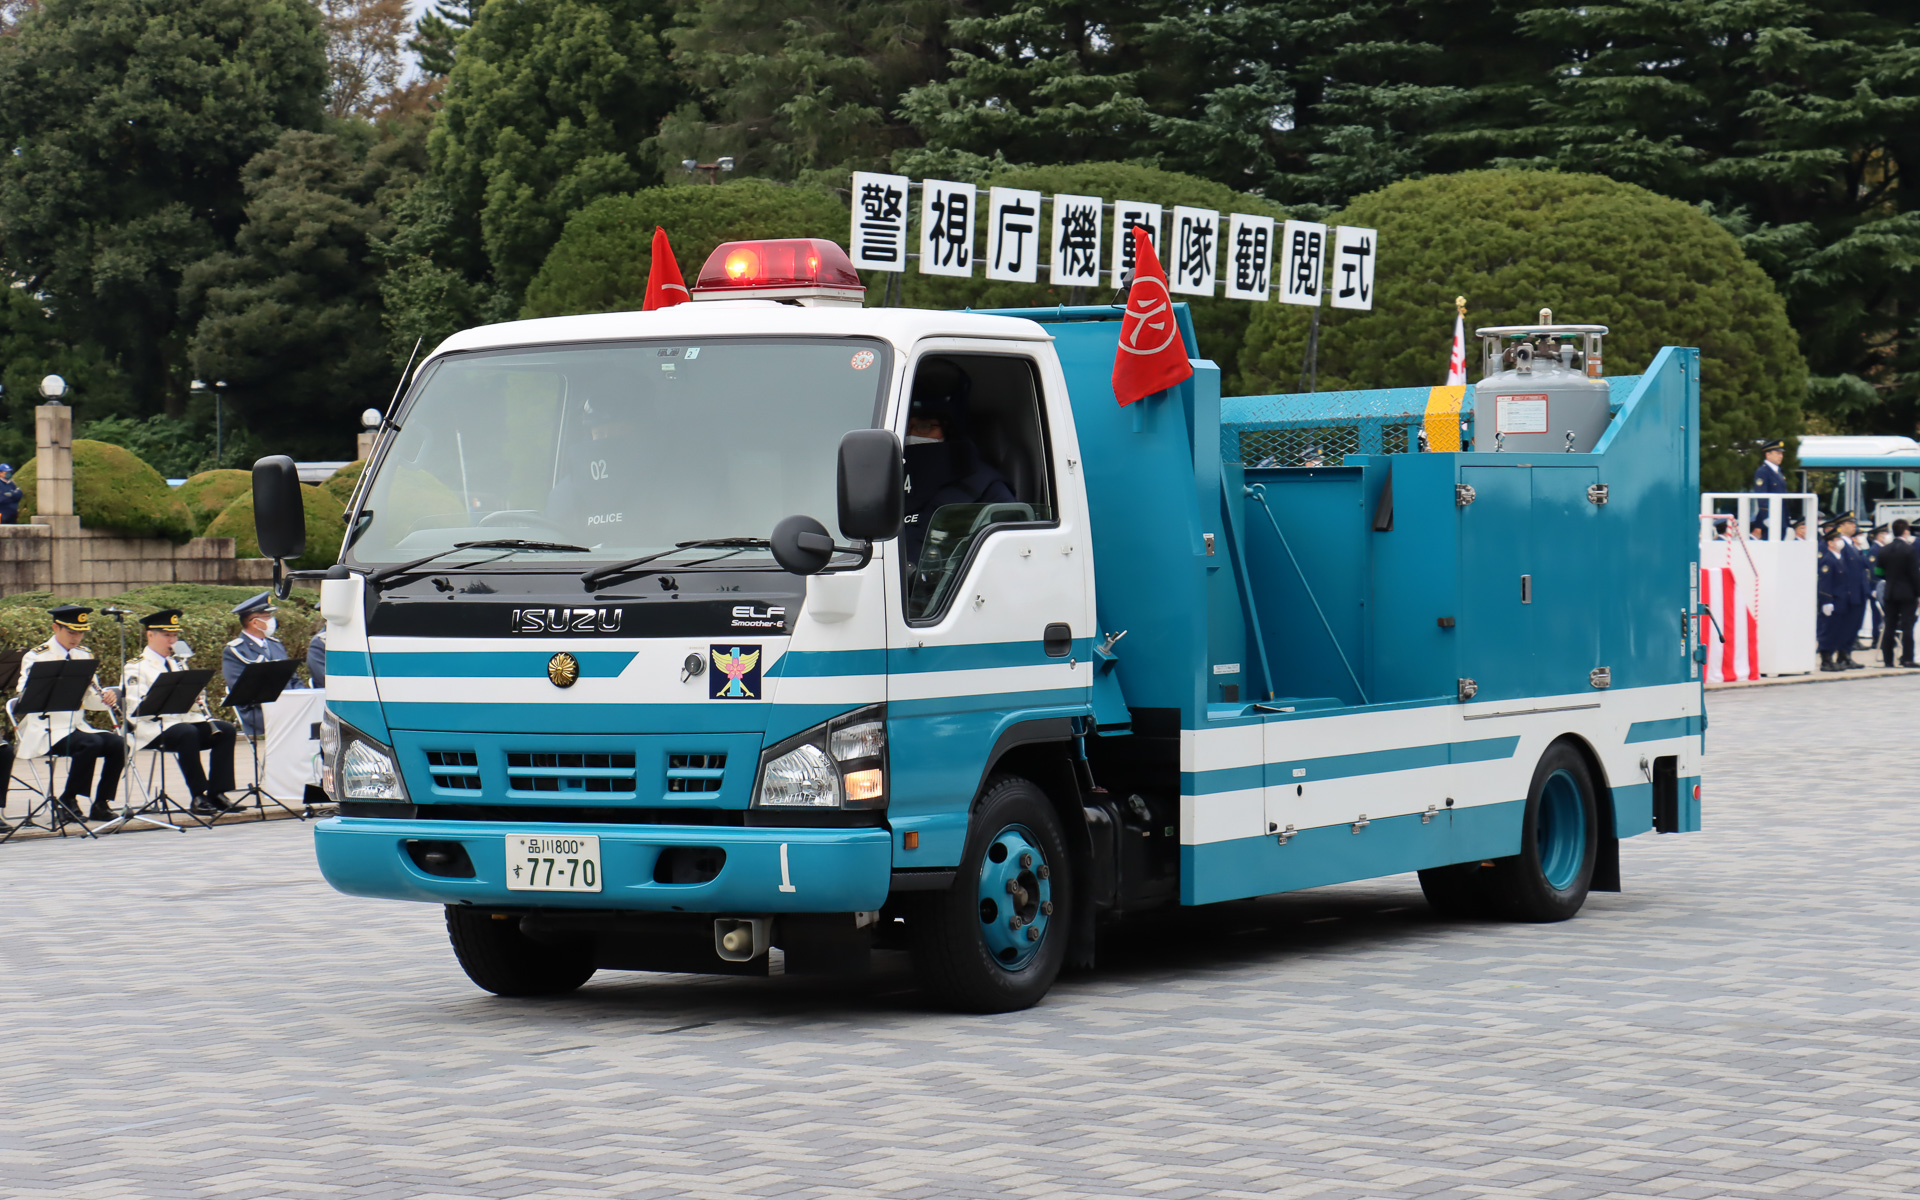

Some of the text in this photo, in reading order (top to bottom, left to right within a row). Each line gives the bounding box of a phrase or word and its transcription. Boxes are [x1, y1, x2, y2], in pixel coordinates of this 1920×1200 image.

[590, 459, 609, 481] 02
[587, 512, 623, 526] POLICE
[511, 608, 623, 633] ISUZU
[732, 605, 786, 618] ELF
[527, 857, 596, 887] 77-70
